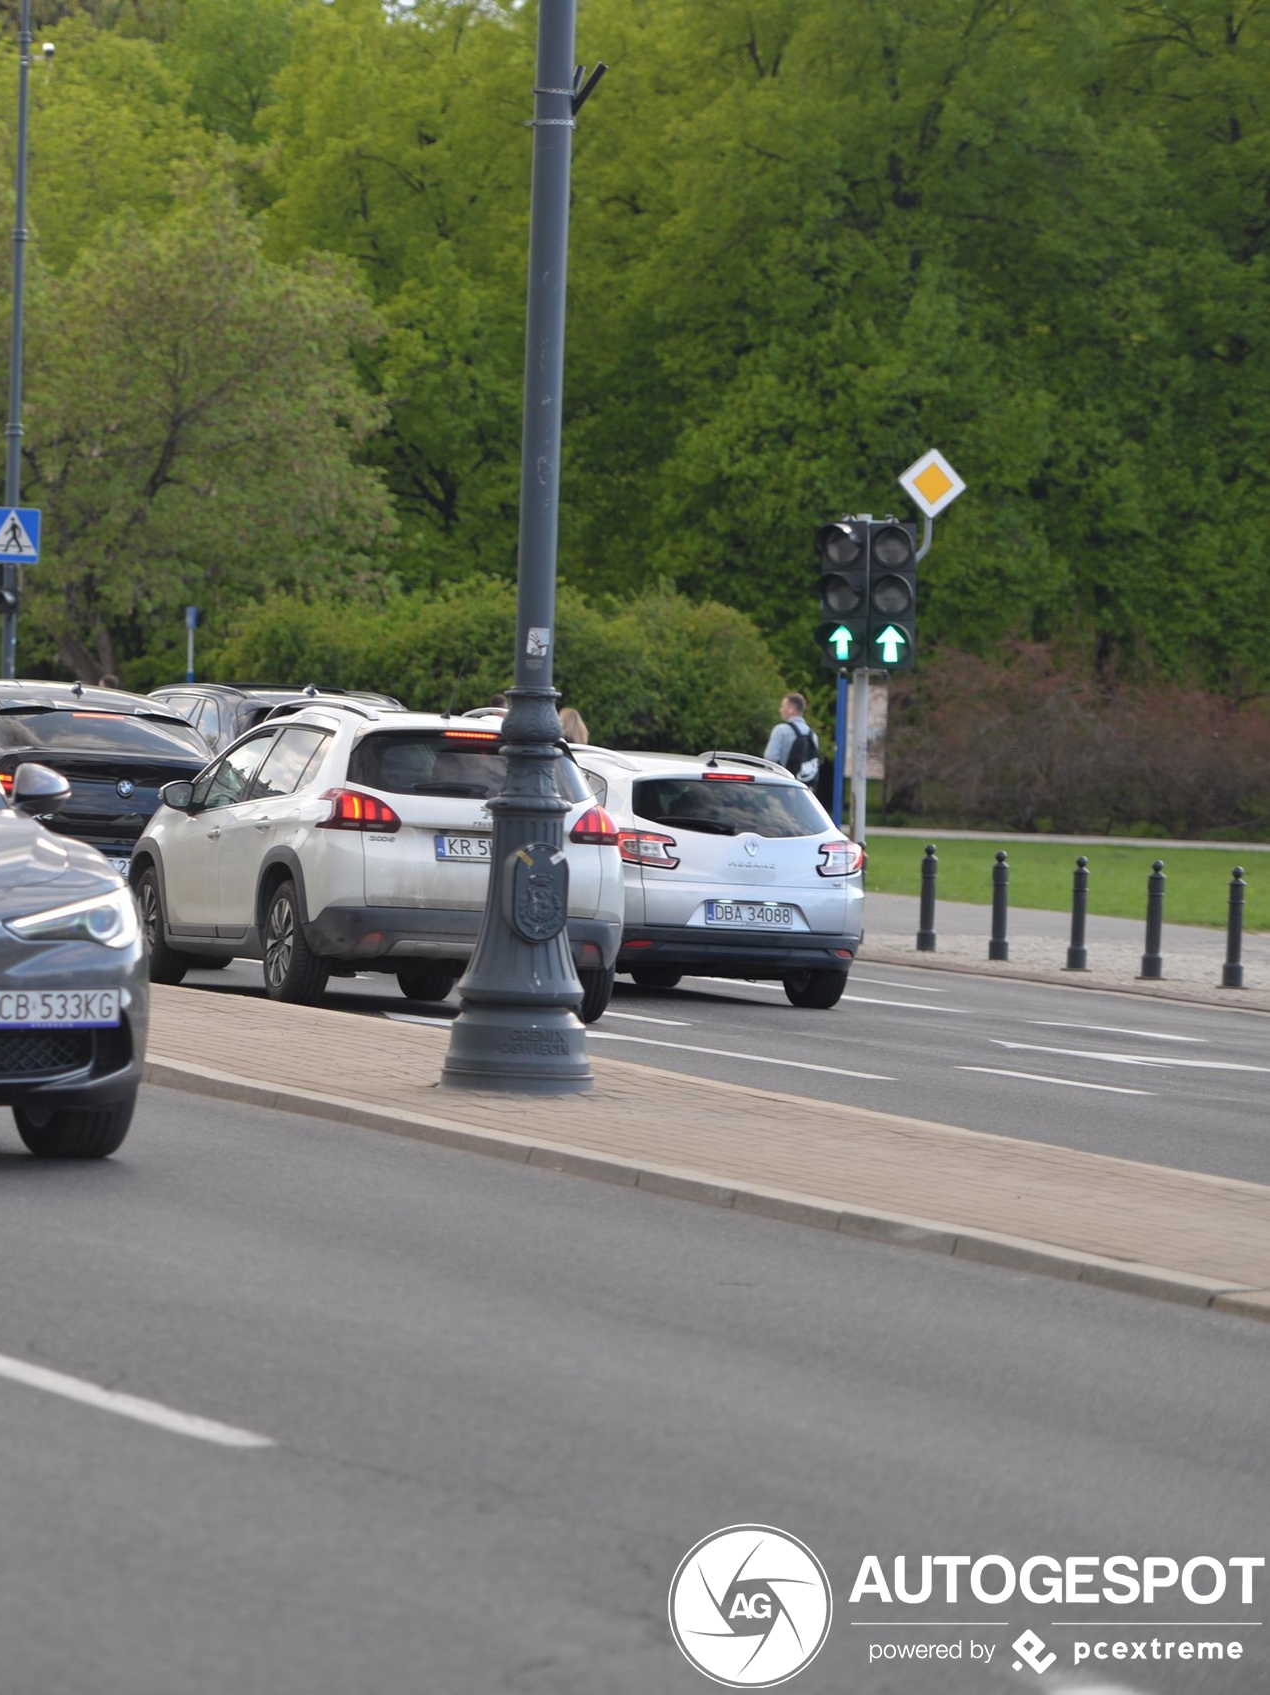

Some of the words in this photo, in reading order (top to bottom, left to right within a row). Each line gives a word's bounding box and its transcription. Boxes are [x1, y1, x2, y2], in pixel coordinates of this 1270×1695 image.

[448, 838, 472, 856] KR
[478, 840, 492, 856] 5
[715, 905, 743, 921] DBA
[747, 906, 791, 924] 34088
[39, 992, 114, 1020] 533KG
